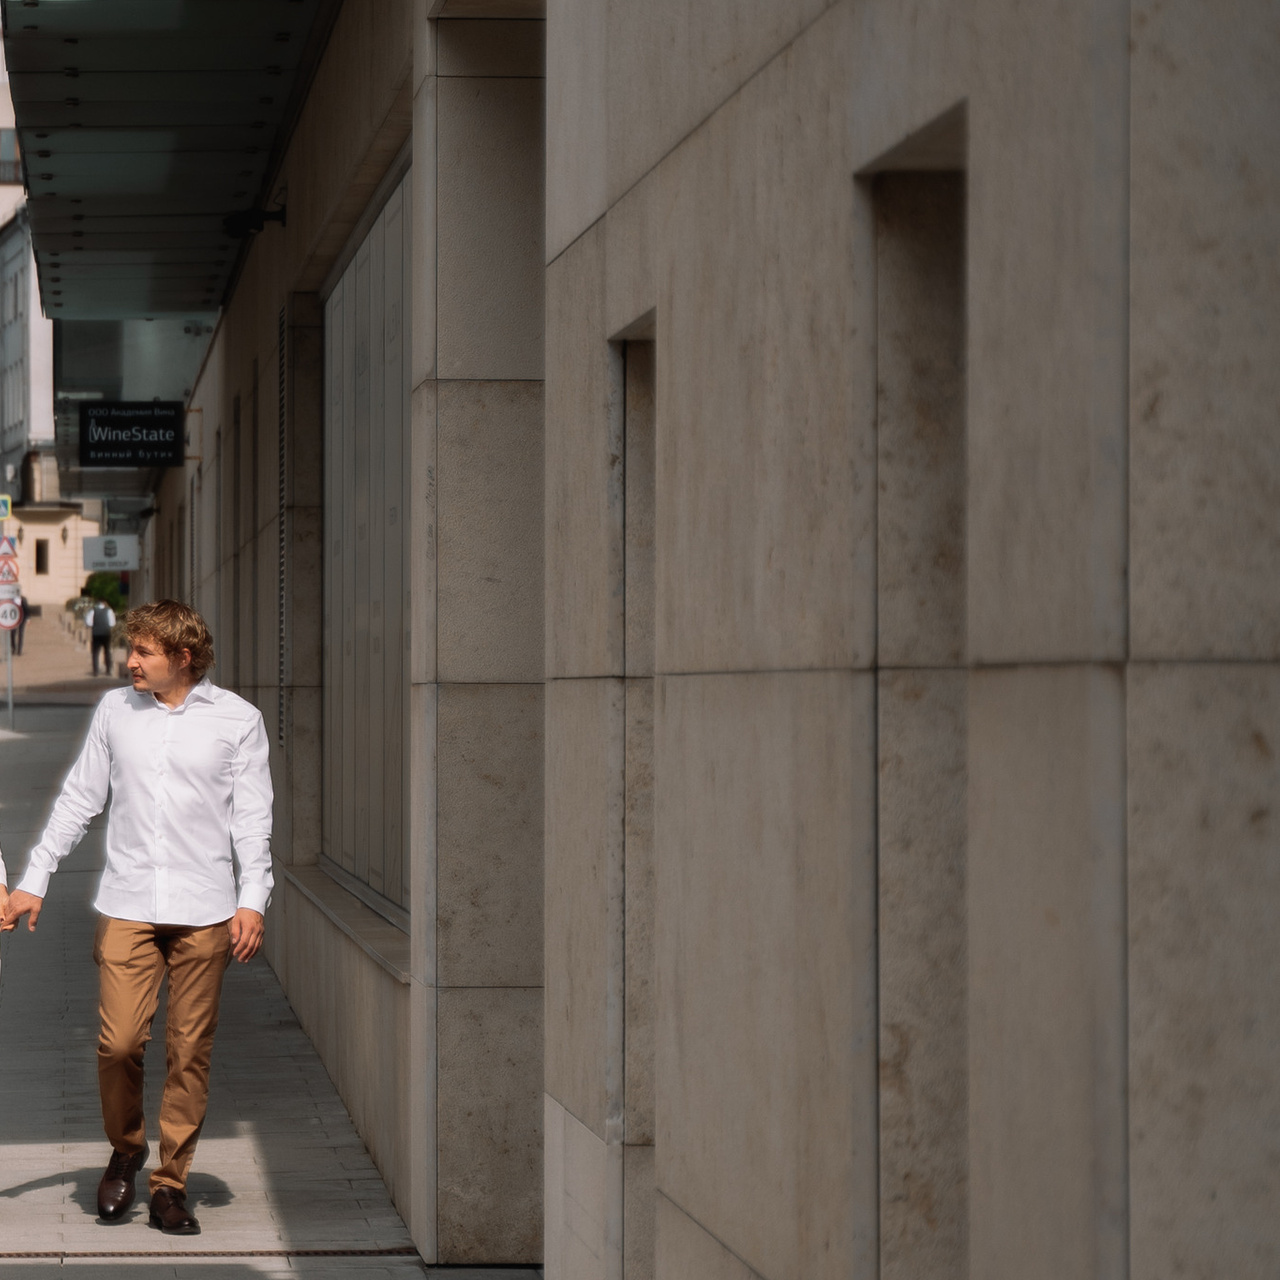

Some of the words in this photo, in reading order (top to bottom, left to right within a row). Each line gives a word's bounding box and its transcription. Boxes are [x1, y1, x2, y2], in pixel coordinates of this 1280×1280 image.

[88, 408, 109, 417] ООО
[154, 407, 175, 417] Вина
[91, 426, 175, 441] WineState
[138, 449, 173, 461] бутик
[0, 608, 18, 621] 40
